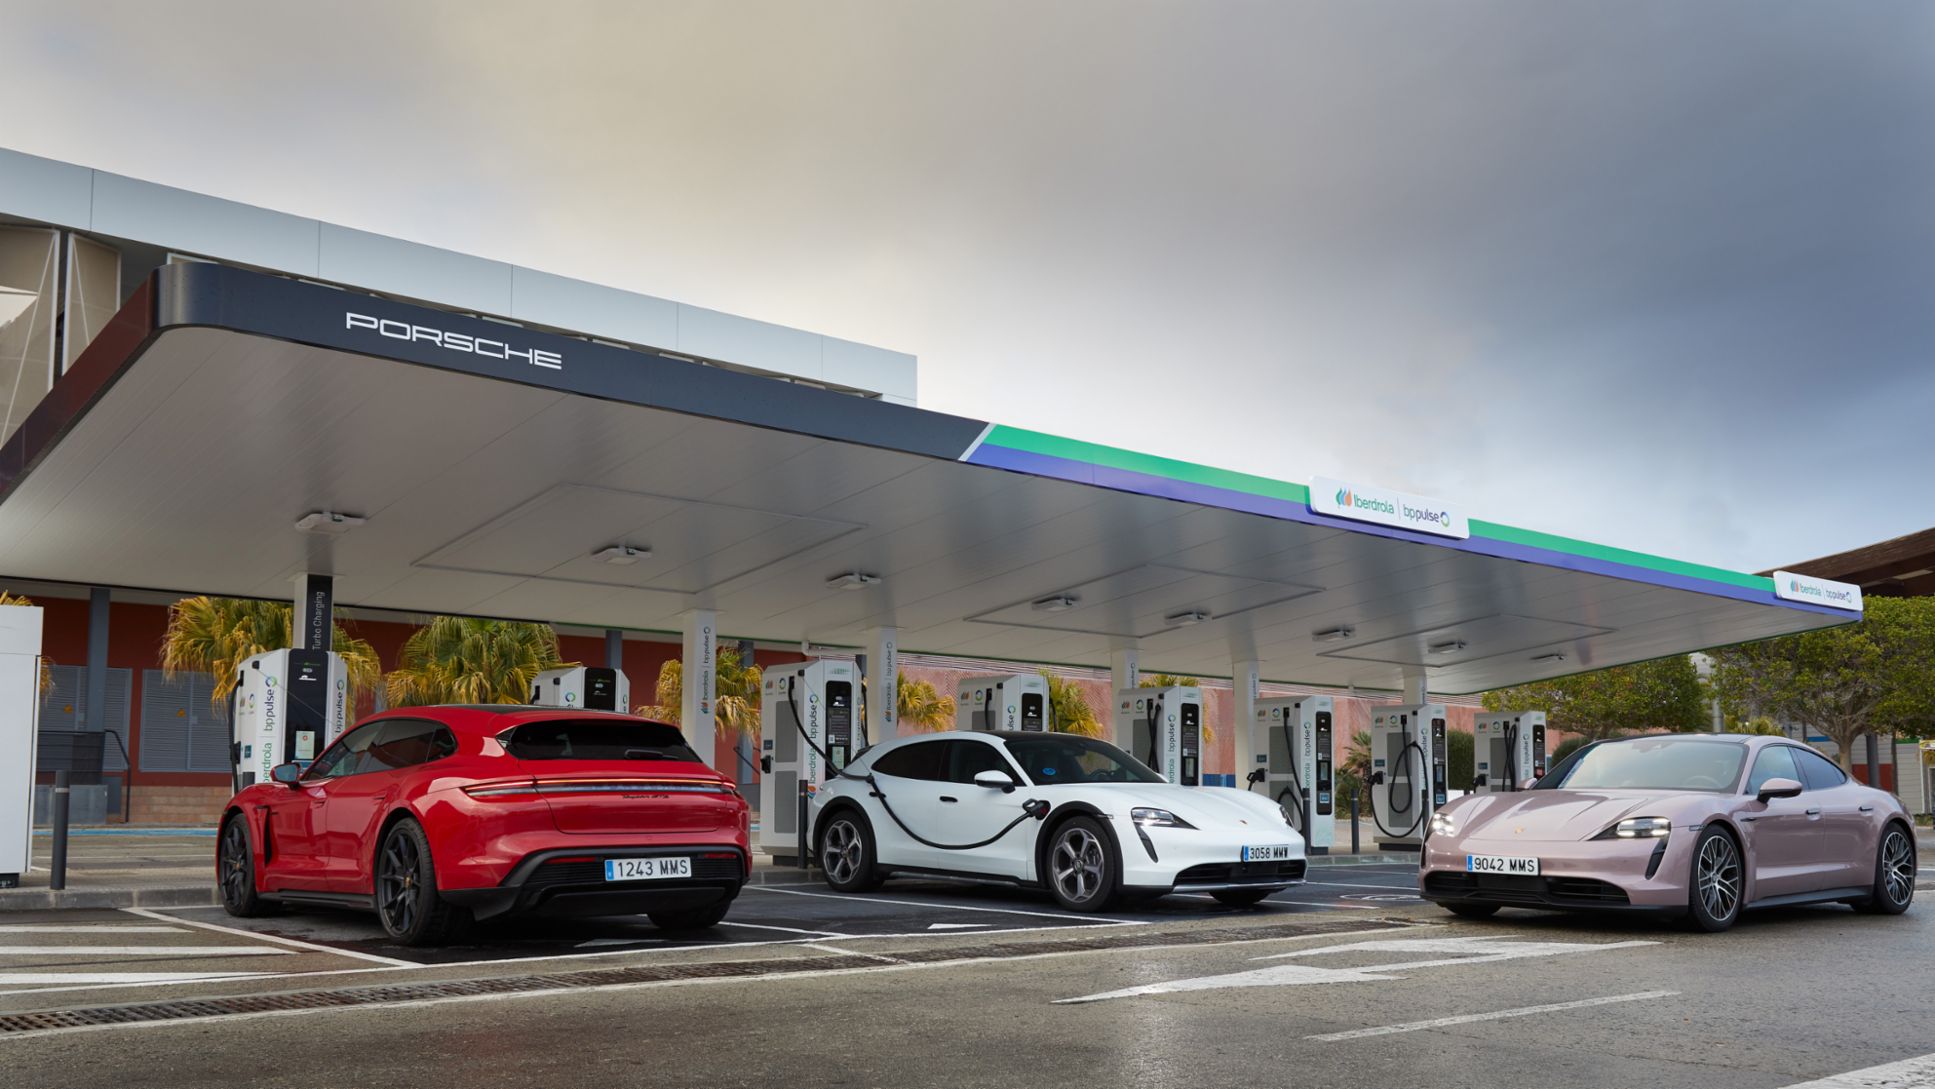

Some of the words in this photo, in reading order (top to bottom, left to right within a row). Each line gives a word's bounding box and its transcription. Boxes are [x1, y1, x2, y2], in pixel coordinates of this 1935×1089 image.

[346, 312, 562, 370] PORSCHE
[1354, 493, 1394, 514] Iberdrola
[313, 591, 325, 627] Charging
[312, 629, 322, 651] Turbo
[1249, 847, 1271, 859] 3058
[618, 861, 653, 878] 1243
[660, 859, 688, 875] MMS
[1474, 857, 1504, 872] 9042
[1509, 859, 1535, 872] MMS
